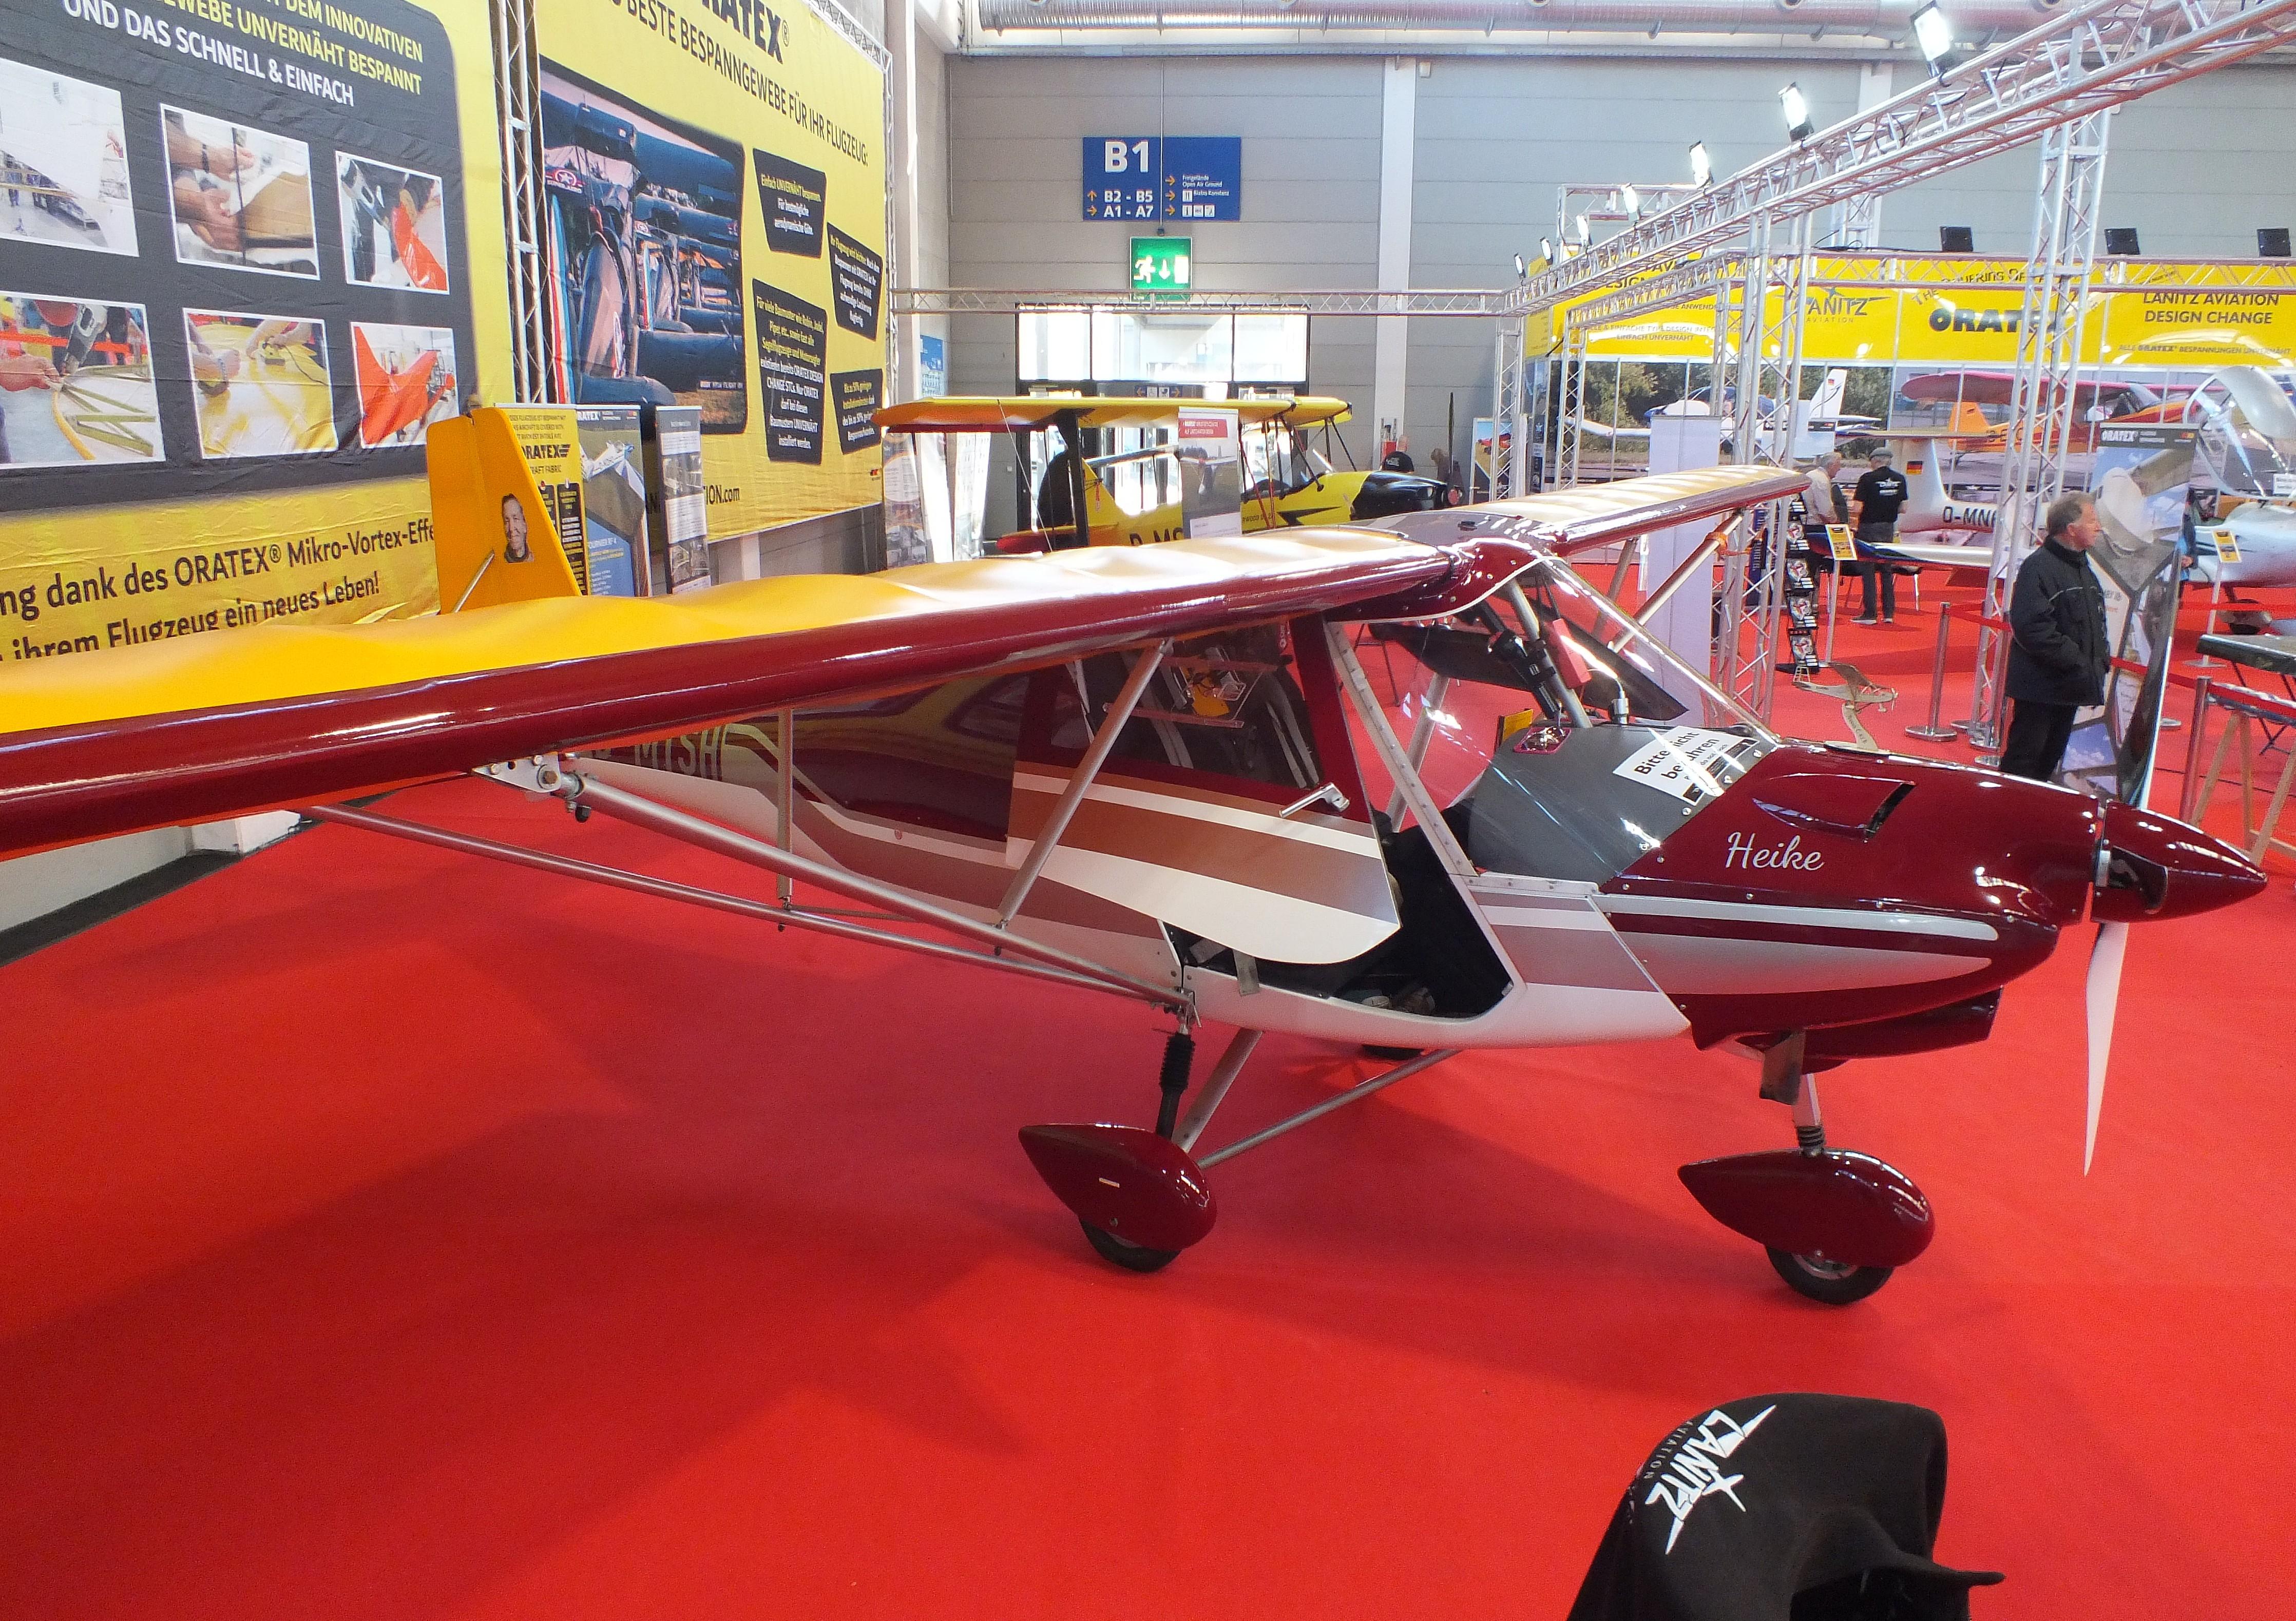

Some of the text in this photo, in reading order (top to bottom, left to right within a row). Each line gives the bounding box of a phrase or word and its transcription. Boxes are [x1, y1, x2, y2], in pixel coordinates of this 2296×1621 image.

[325, 4, 423, 63] INNOVATIVEN
[63, 0, 354, 107] UND DAS SCHNELL & EINFACH
[237, 7, 345, 67] UNVERNÄHT
[348, 49, 423, 95] BESPANNT
[627, 0, 869, 167] BESTE BESPANNGEWEBE FÜR IHR FLUGZEUG:
[1104, 140, 1149, 173] B1
[1103, 205, 1121, 218] A1
[1135, 205, 1154, 218] A7
[1104, 190, 1121, 203] B2
[1136, 190, 1153, 203] B5
[1911, 288, 1939, 305] THE
[2143, 292, 2280, 306] LANITZ AVIATION
[2144, 310, 2273, 324] DESIGN CHANGE
[703, 484, 740, 505] ION.com
[47, 566, 118, 608] dank
[124, 562, 169, 595] des
[12, 570, 380, 660] ihrem Flugzeug ein neues Leben!
[1634, 749, 1669, 775] Bitte
[1725, 832, 1825, 871] Heike
